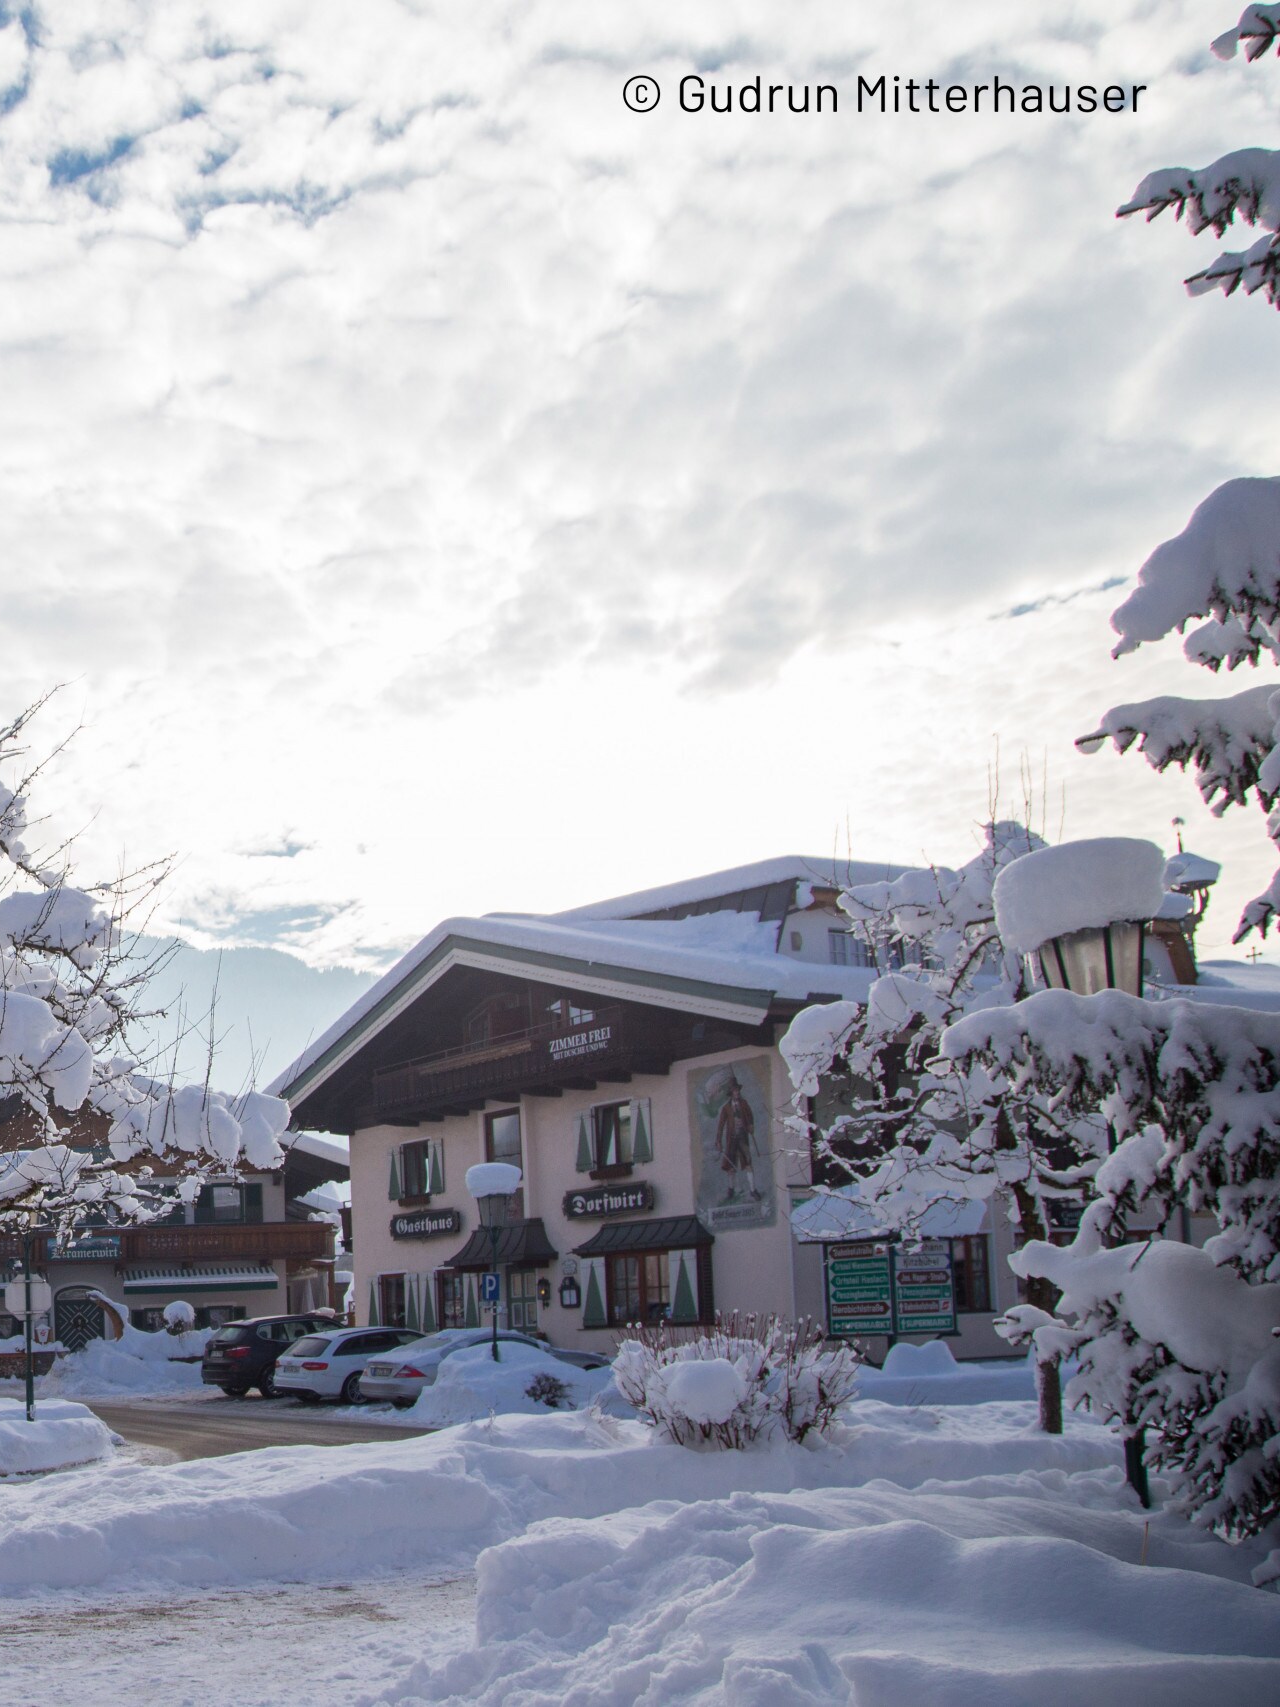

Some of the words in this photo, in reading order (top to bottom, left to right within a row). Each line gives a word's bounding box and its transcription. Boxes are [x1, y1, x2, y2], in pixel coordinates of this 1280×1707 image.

[549, 1033, 588, 1053] ZIMMER
[589, 1026, 612, 1043] FREI
[553, 1052, 564, 1060] MIT
[564, 1046, 586, 1058] DUSCHE
[586, 1044, 599, 1053] UND
[599, 1040, 608, 1049] WC
[573, 1191, 644, 1214] Dorfwirt
[396, 1215, 453, 1235] Gasthaus
[903, 1256, 939, 1266] Kitzbühel
[486, 1275, 496, 1299] P
[835, 1275, 860, 1285] Ortsteil
[906, 1318, 950, 1328] SUPERMARKT
